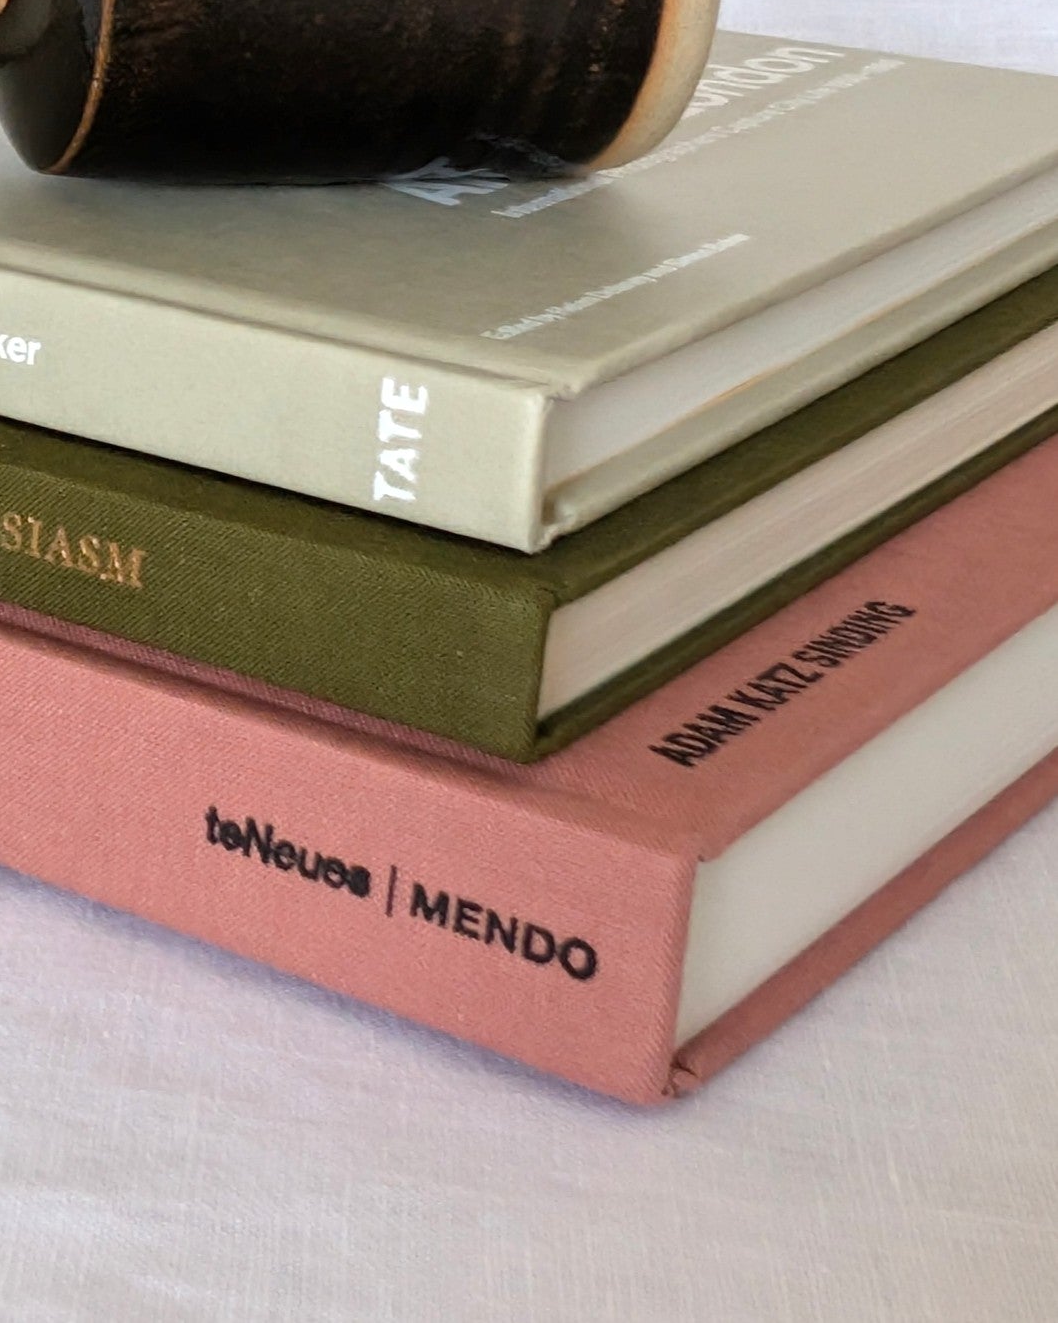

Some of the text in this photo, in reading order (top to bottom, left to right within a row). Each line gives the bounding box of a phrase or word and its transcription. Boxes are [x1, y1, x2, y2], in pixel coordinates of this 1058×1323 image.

[681, 46, 845, 121] ondon
[372, 376, 430, 503] TATE
[648, 600, 917, 767] ADAM KATZ SINDING
[410, 882, 598, 980] MENDO
